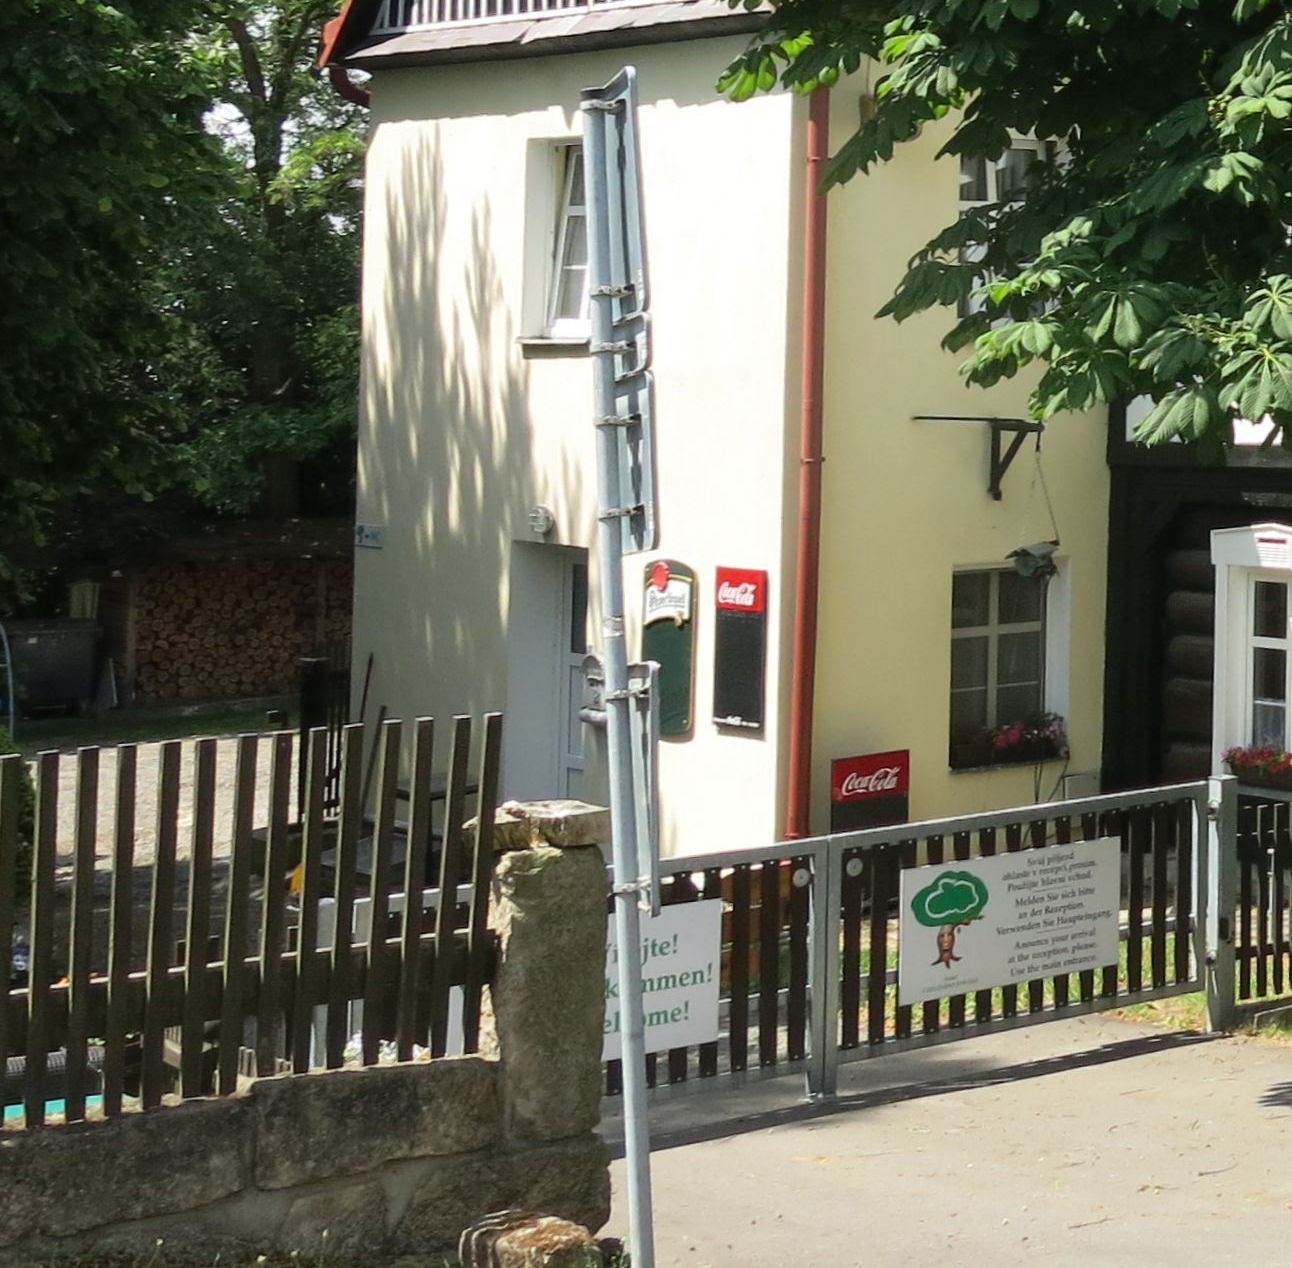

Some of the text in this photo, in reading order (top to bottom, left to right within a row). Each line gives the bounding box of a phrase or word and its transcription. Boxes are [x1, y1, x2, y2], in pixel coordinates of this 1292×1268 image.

[1015, 894, 1045, 907] Melden
[1047, 892, 1060, 901] Sie
[1061, 889, 1077, 899] sich
[1019, 911, 1028, 919] an
[1030, 908, 1043, 917] der
[1042, 918, 1056, 927] Sie
[1017, 952, 1029, 963] the
[1010, 967, 1025, 977] Use
[1027, 963, 1039, 973] the
